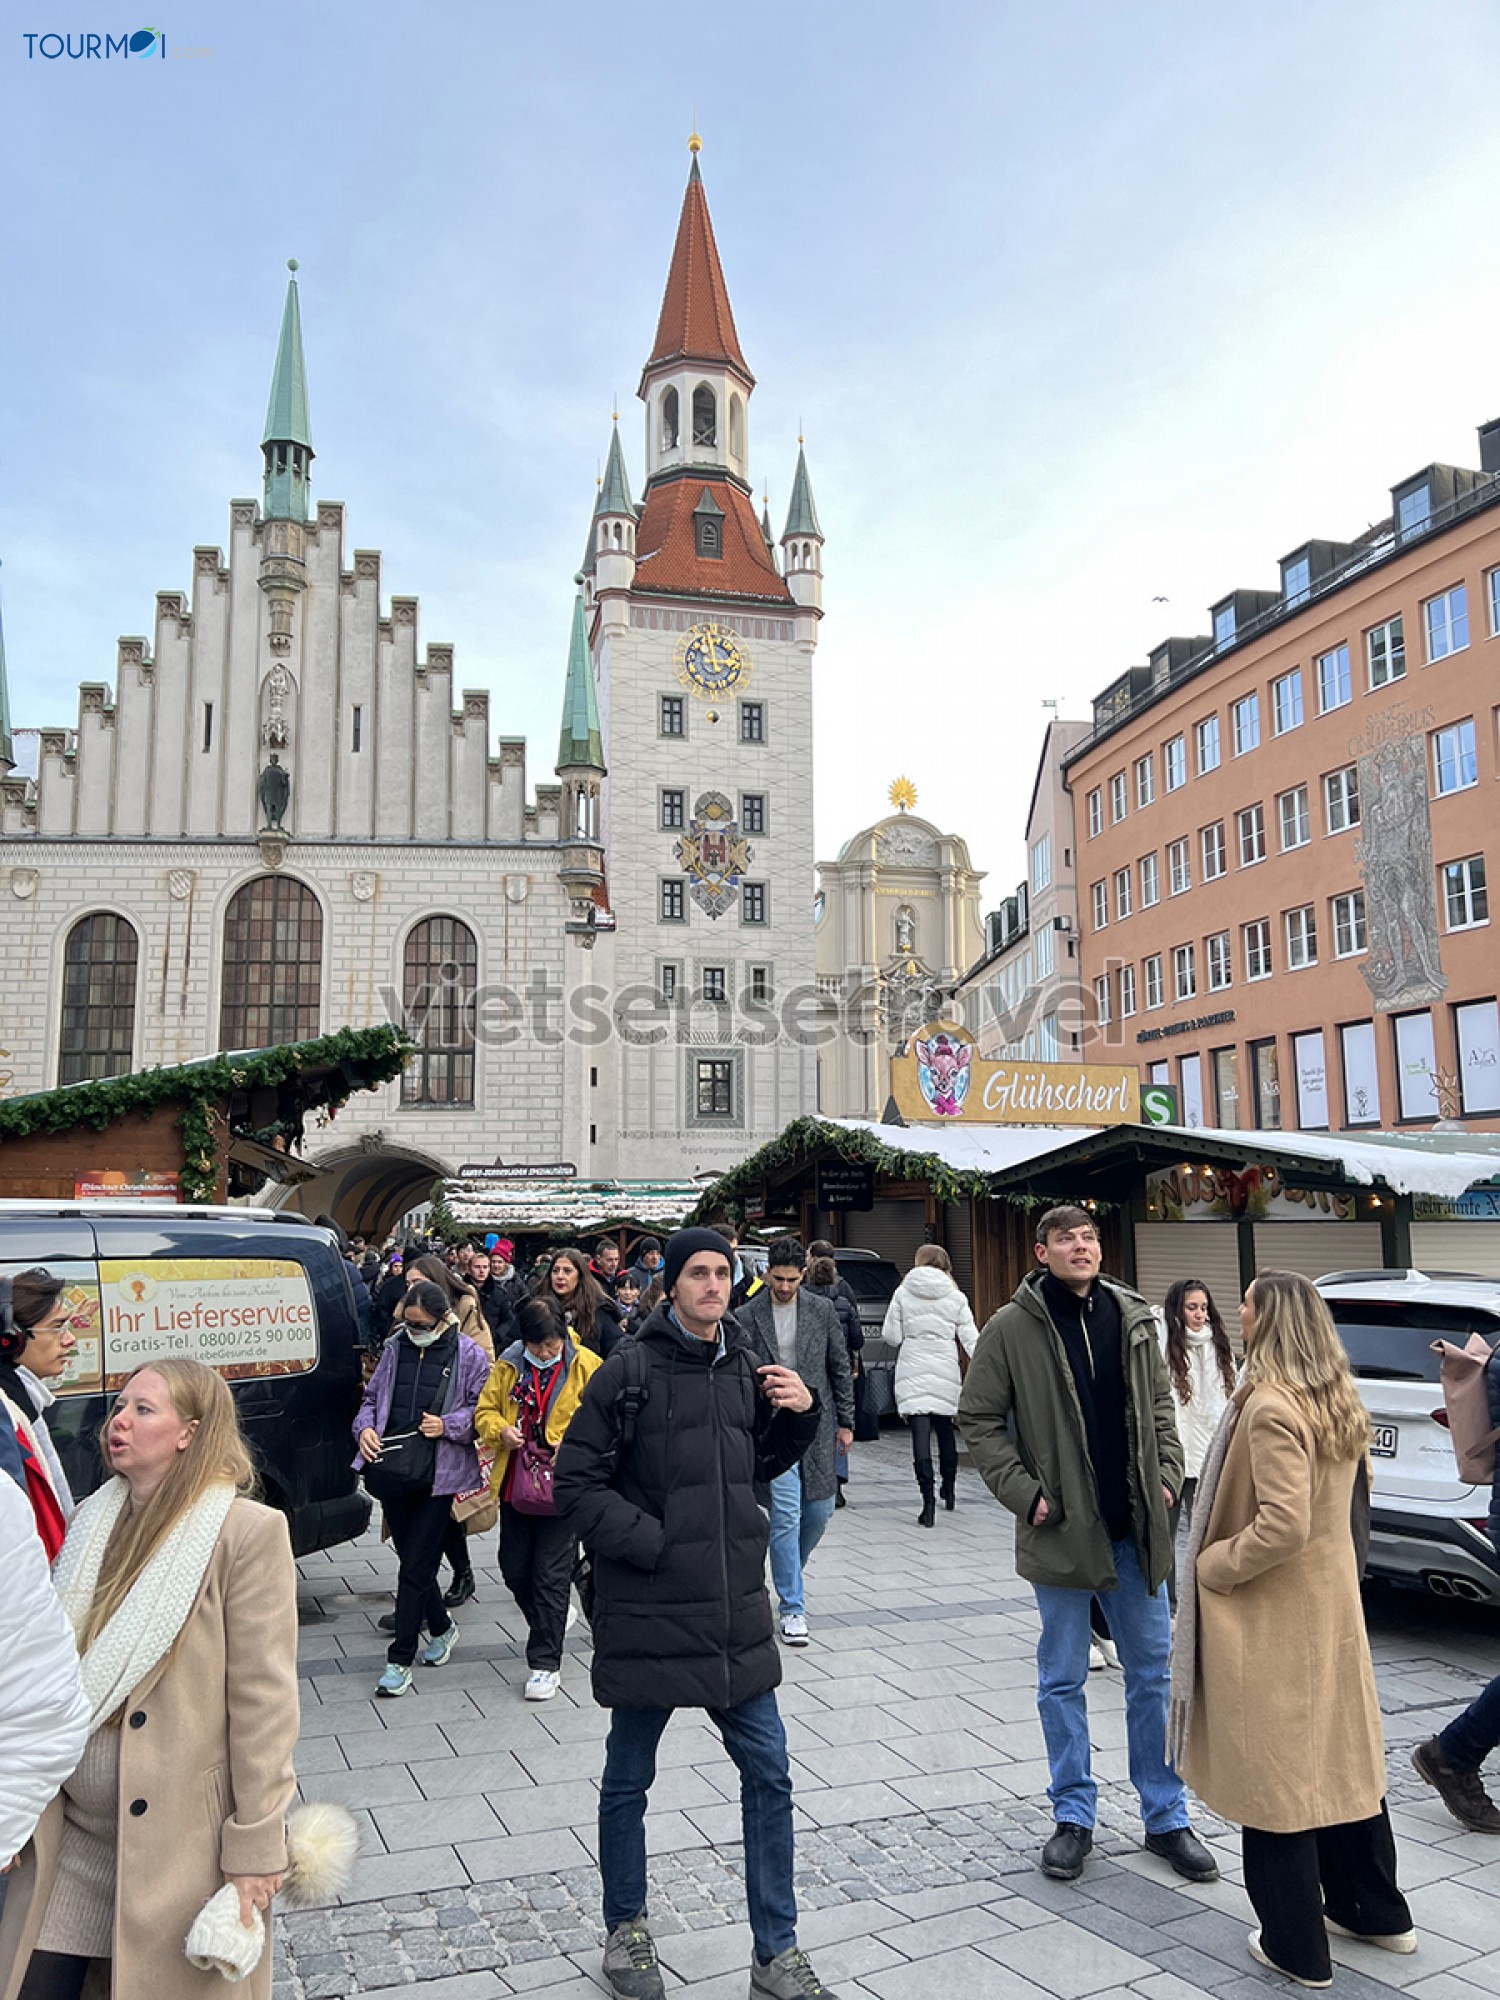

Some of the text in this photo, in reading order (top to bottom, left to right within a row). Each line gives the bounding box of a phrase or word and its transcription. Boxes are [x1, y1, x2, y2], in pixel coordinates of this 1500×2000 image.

[983, 1069, 1131, 1116] Glühscherl
[1145, 1091, 1171, 1126] S
[109, 1301, 311, 1334] Ihr Lieferservice
[109, 1326, 313, 1353] Gratis-Tel. 0800/25 90 000
